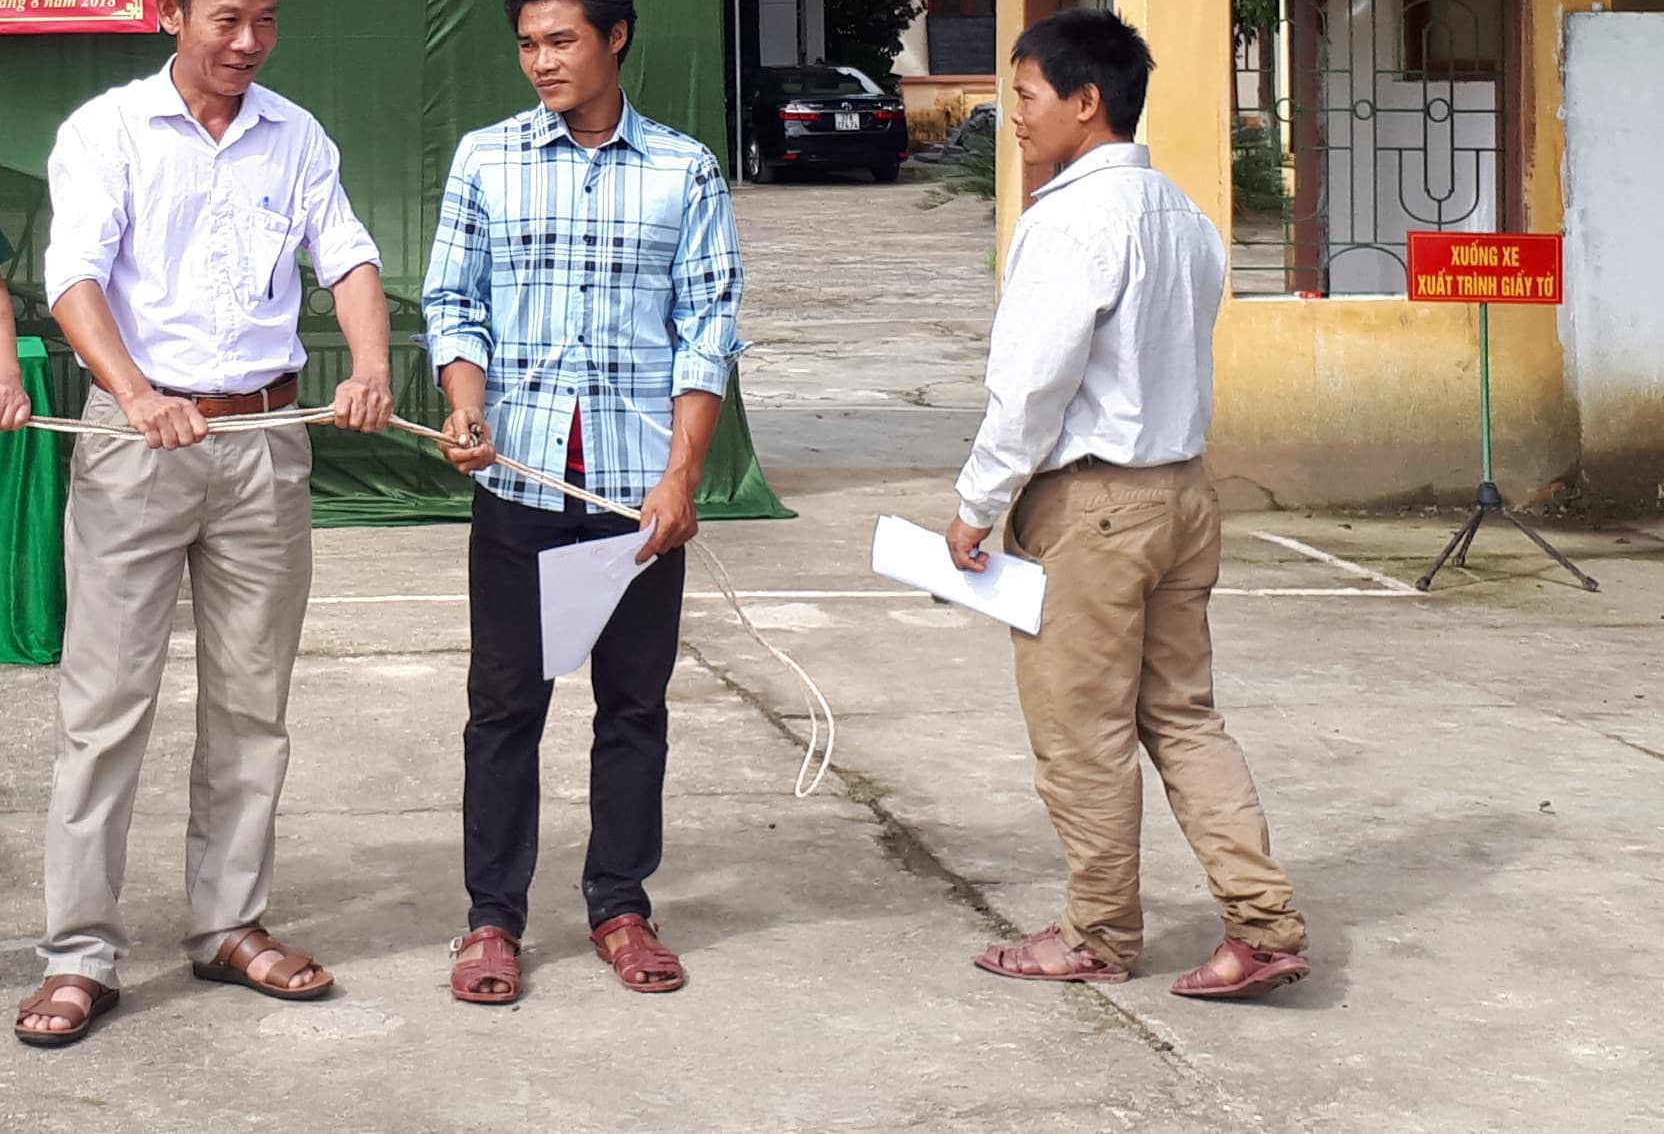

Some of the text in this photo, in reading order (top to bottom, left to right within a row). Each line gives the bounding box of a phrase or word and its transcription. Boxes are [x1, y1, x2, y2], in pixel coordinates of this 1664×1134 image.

[1450, 239, 1520, 267] XUỐNG XE
[1417, 268, 1555, 297] XUẤT TRÌNH GIẤY TỜ
